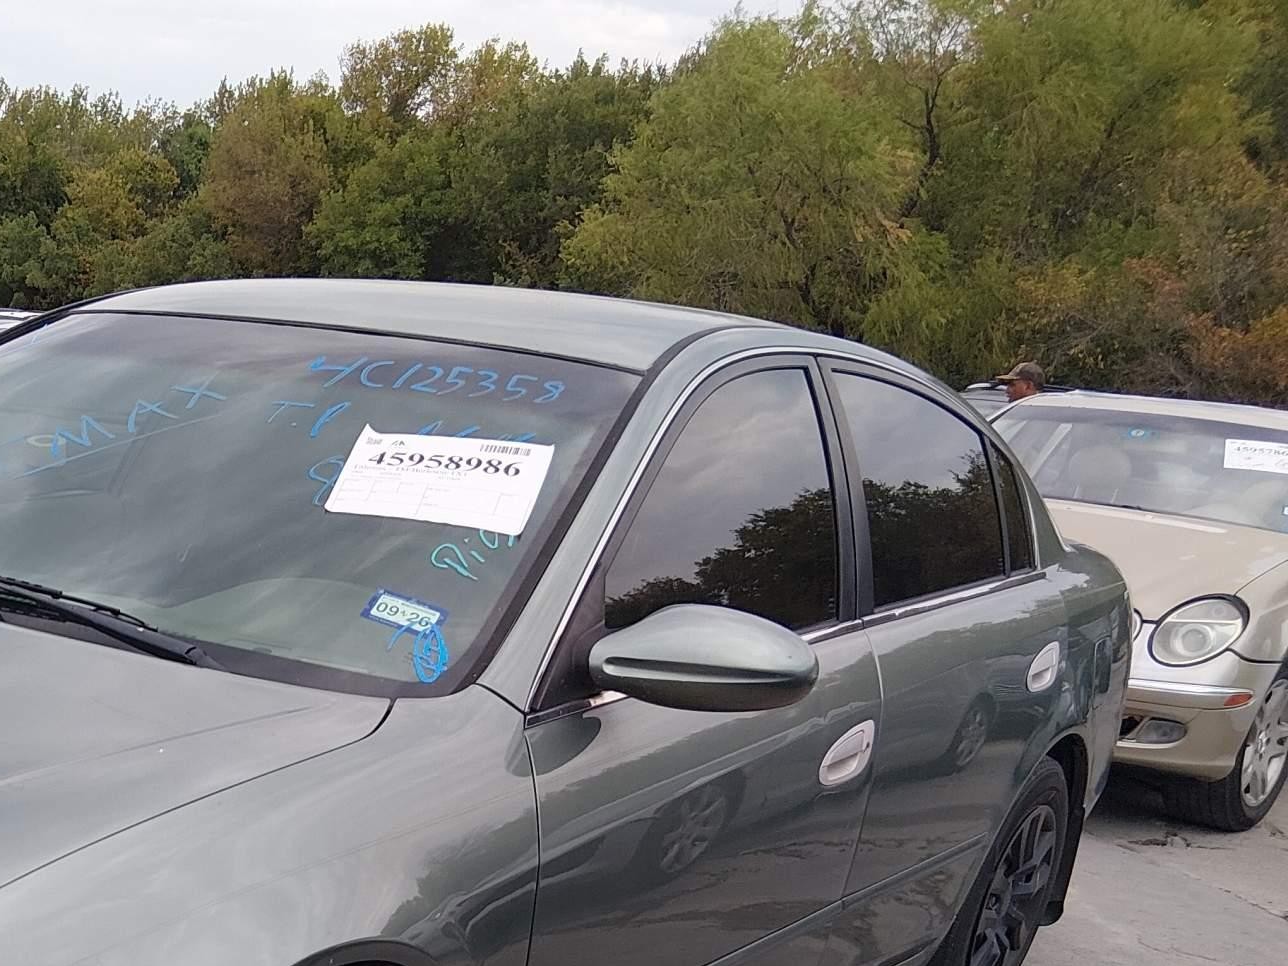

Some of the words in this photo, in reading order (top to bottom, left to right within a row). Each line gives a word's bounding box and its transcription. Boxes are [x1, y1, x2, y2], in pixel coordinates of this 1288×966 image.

[367, 451, 524, 478] 45958986
[376, 602, 400, 617] 09
[406, 612, 431, 628] 26
